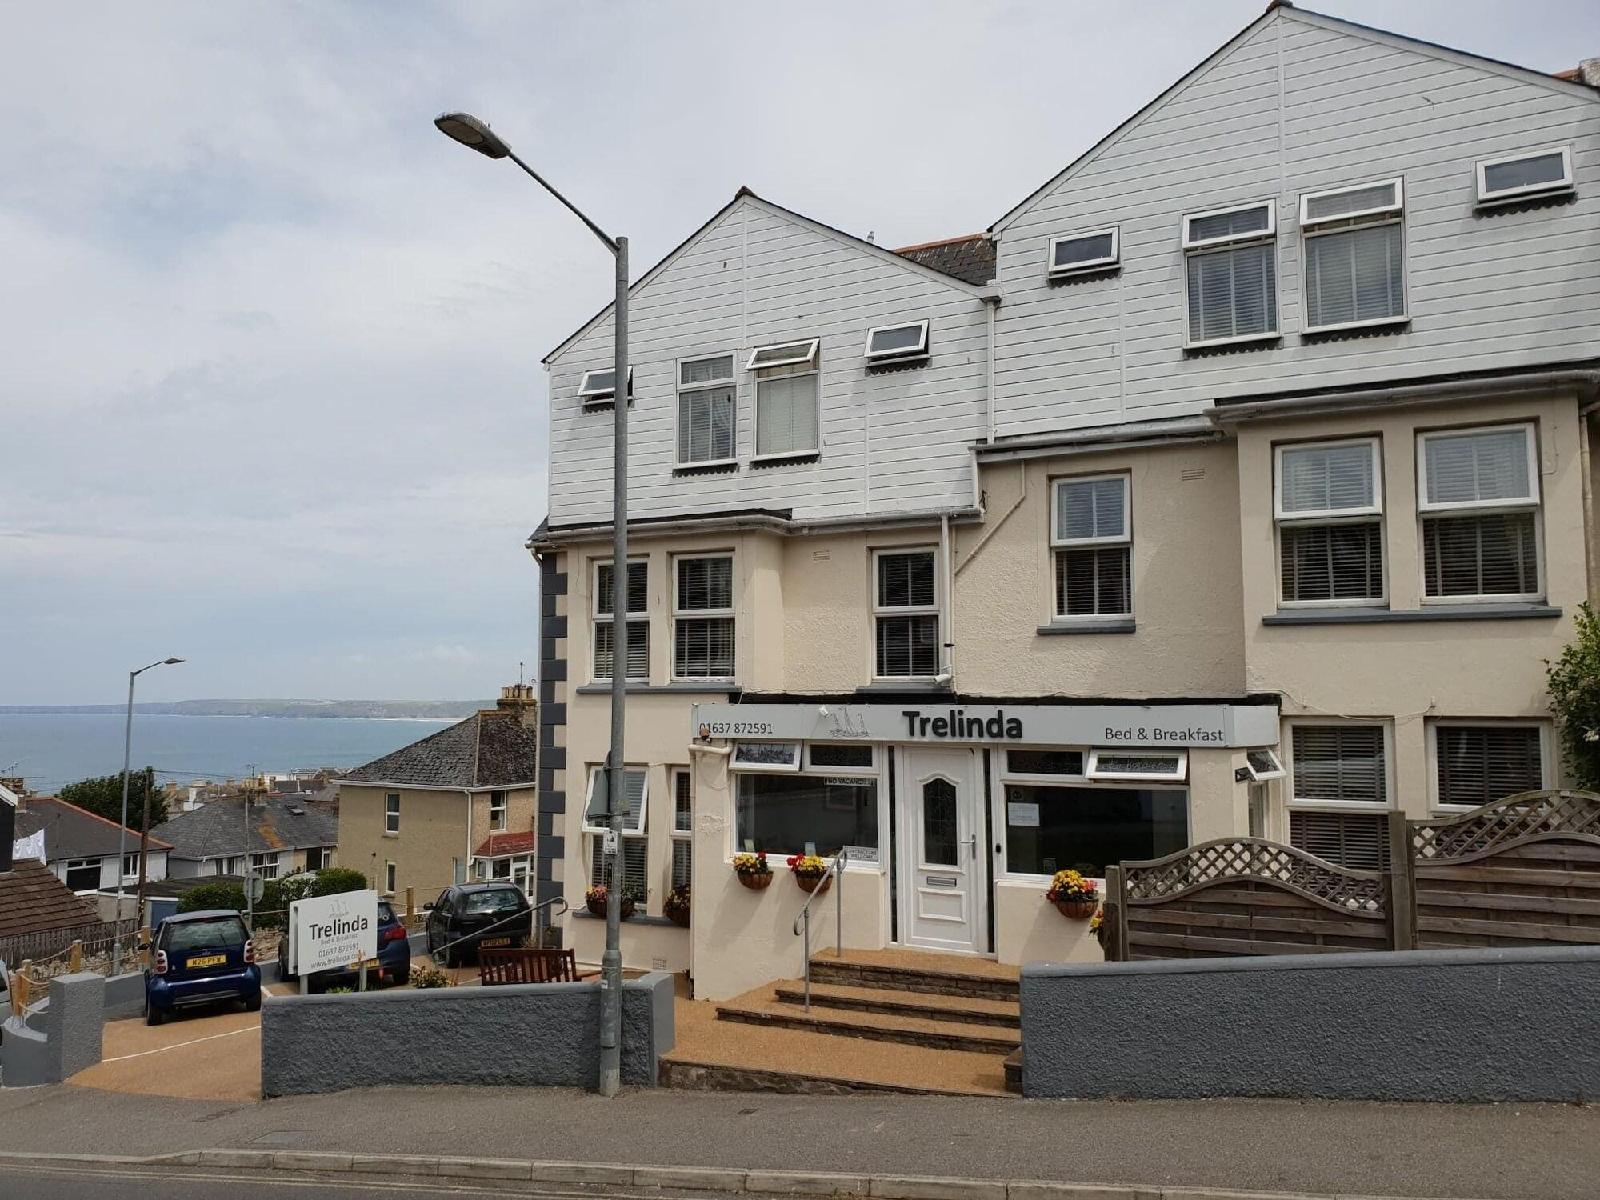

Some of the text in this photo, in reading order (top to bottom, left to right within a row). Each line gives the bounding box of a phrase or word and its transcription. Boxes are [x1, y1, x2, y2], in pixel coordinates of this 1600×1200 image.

[700, 722, 773, 735] 01637 872591
[902, 709, 1023, 739] Trelinda
[1105, 727, 1224, 742] Bed & Breakfast
[309, 915, 369, 940] Trelinda
